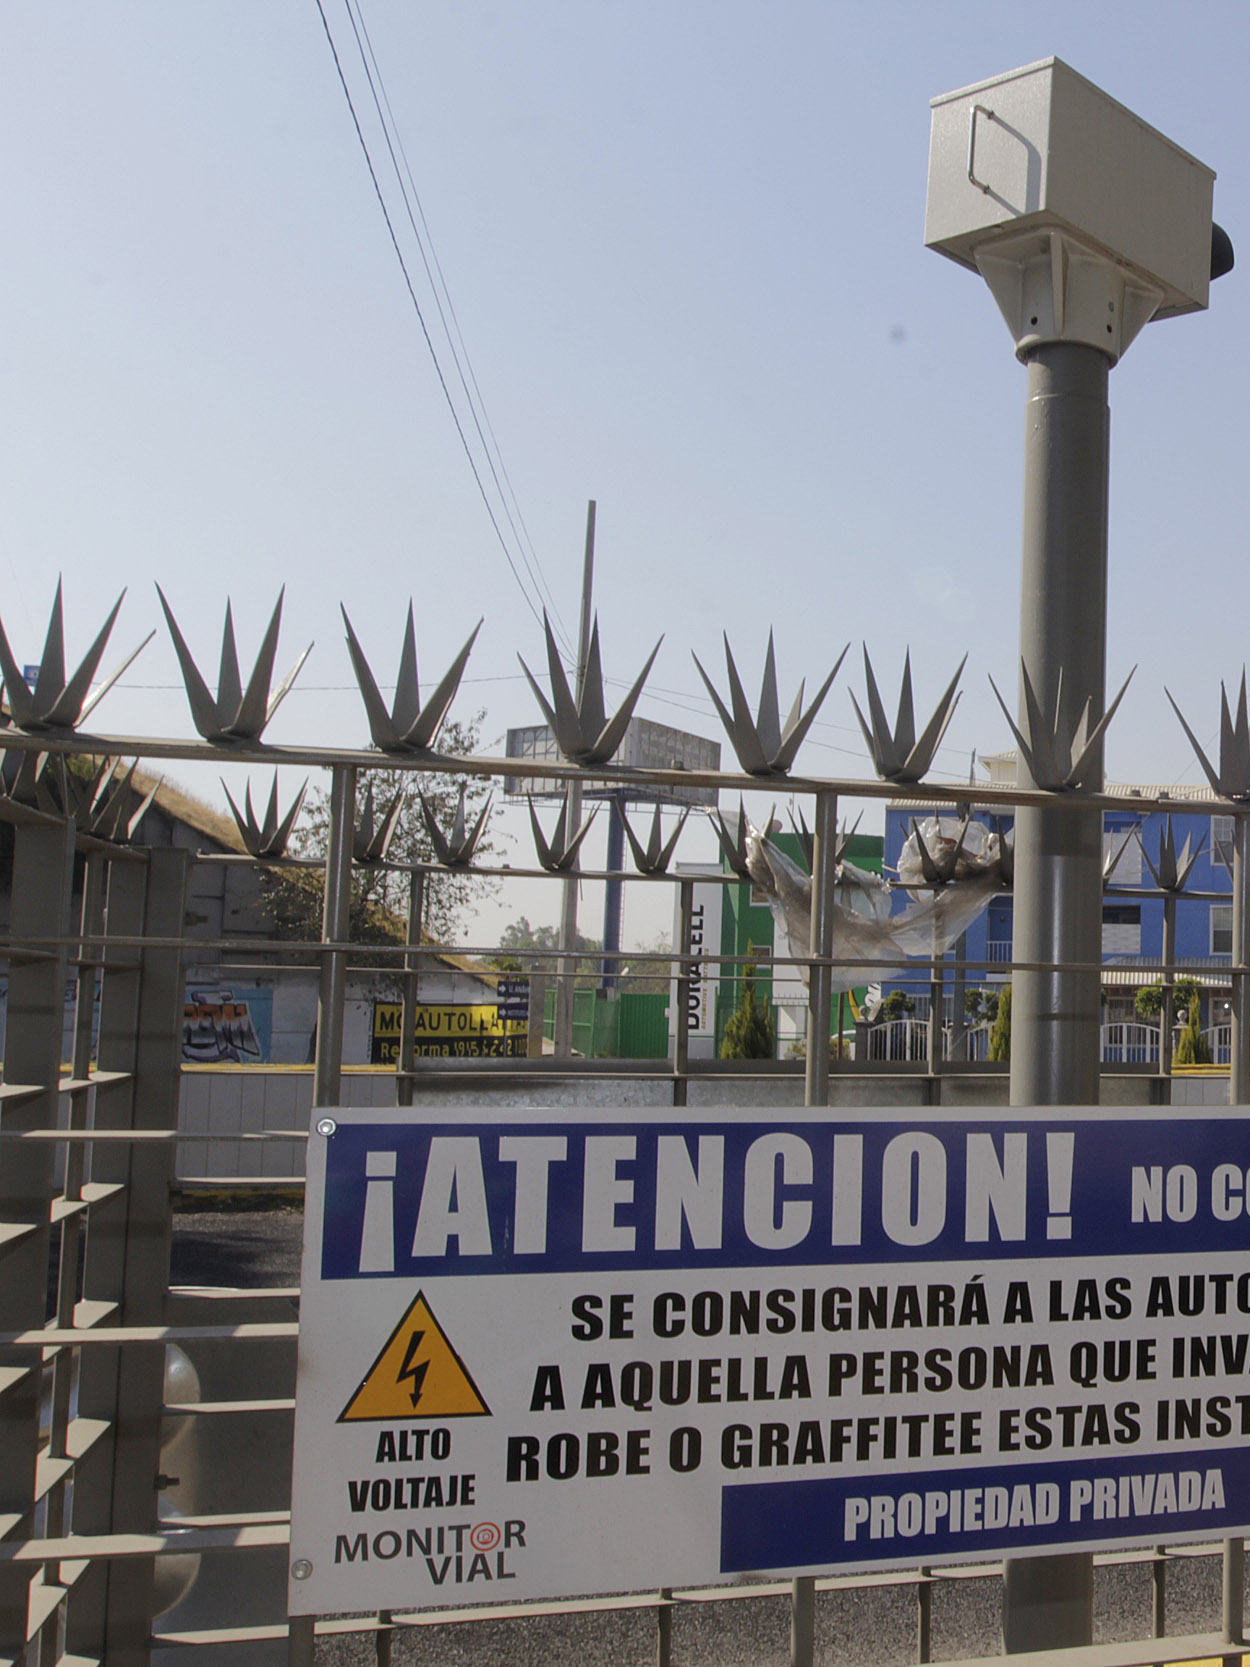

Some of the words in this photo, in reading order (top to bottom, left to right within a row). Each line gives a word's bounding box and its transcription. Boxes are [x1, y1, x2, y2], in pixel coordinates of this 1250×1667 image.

[381, 1042, 450, 1057] Reorma
[358, 1131, 1076, 1273] ¡ATENCION!
[1131, 1164, 1198, 1223] NO
[571, 1293, 634, 1342] SE
[652, 1274, 990, 1339] CONSIGNARÁ
[1002, 1281, 1034, 1325] A
[1048, 1277, 1132, 1323] LAS
[529, 1364, 566, 1412] A
[580, 1354, 812, 1412] AQUELLA
[828, 1343, 1055, 1397] PERSONA
[1069, 1338, 1157, 1389] QUE
[375, 1427, 451, 1463] ALTO
[506, 1429, 651, 1483] ROBE
[669, 1426, 702, 1473] O
[720, 1411, 982, 1470] GRAFFITEE
[998, 1401, 1141, 1452] ESTAS
[347, 1473, 476, 1513] VOLTAJE
[844, 1482, 1060, 1542] PROPIEDAD
[1069, 1468, 1226, 1523] PRIVADA
[334, 1519, 527, 1564] MONITOR
[425, 1551, 517, 1586] VIAL
